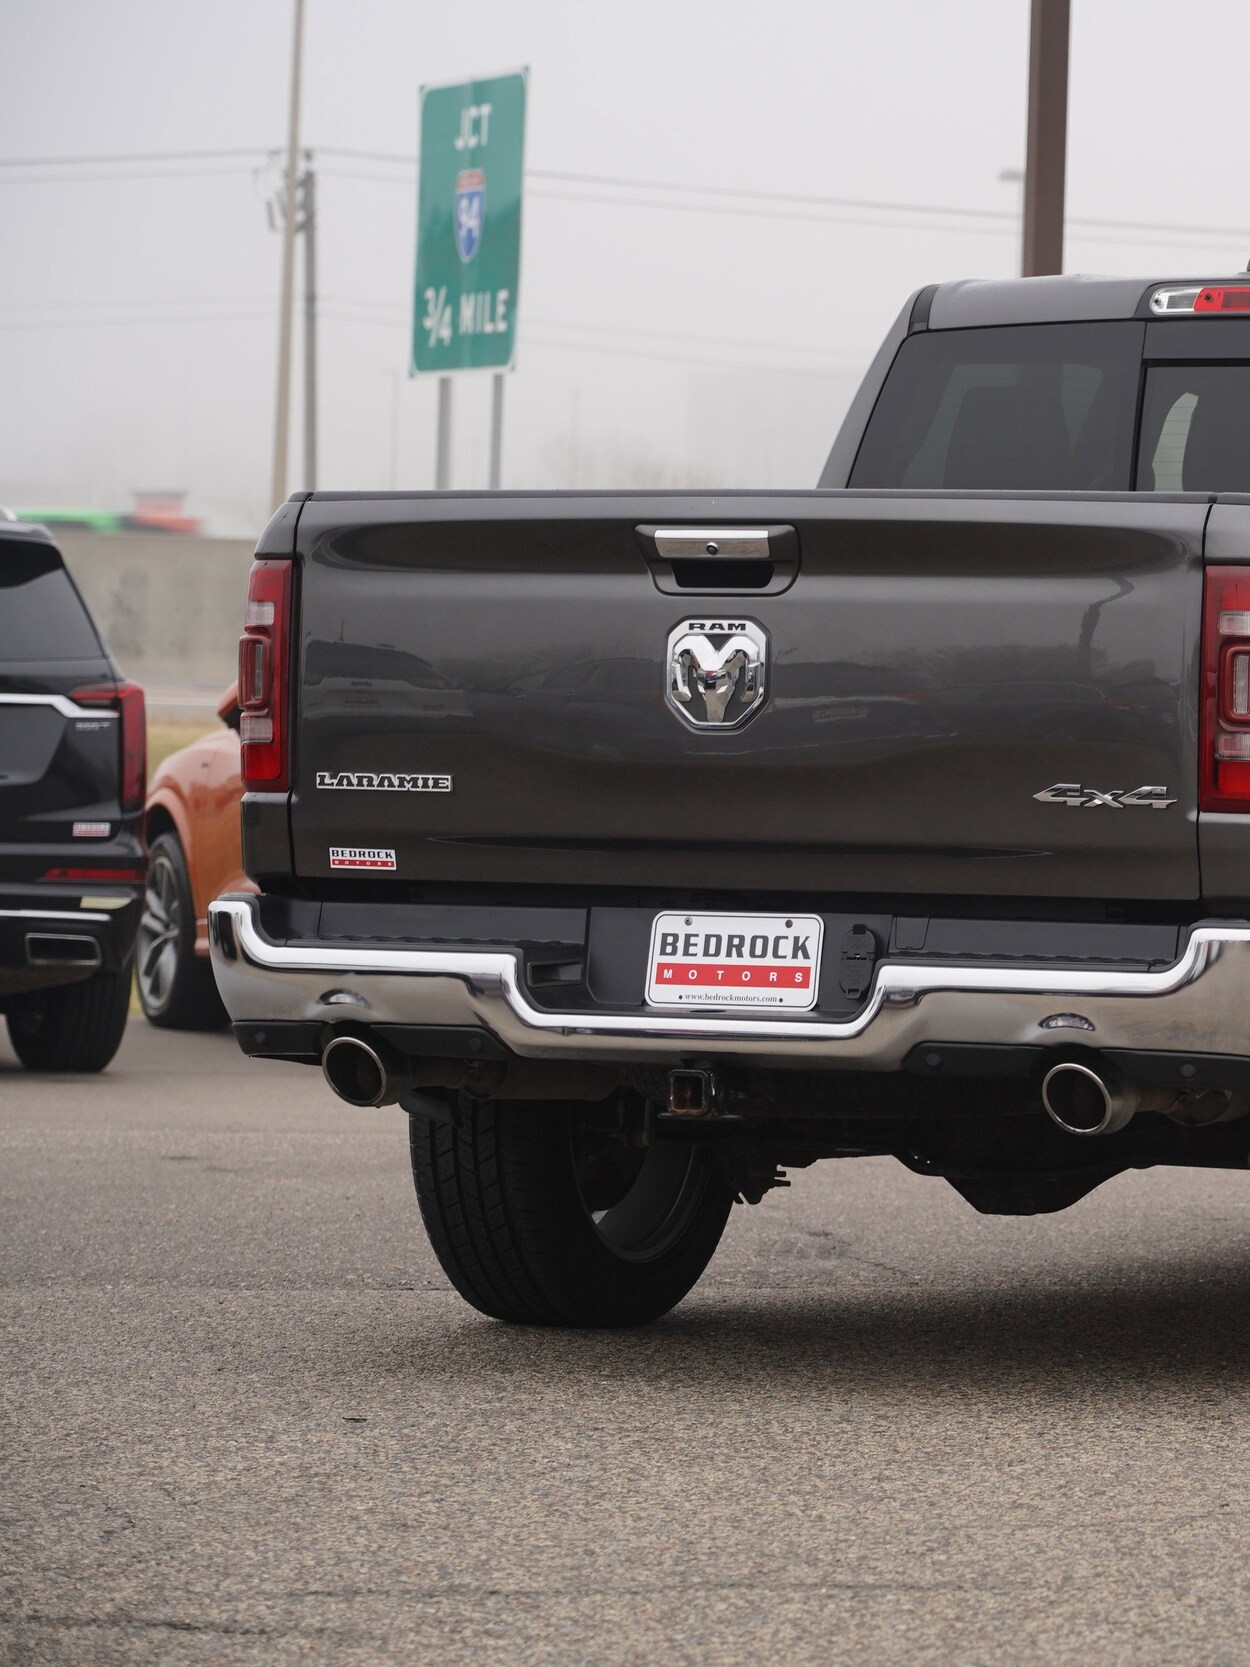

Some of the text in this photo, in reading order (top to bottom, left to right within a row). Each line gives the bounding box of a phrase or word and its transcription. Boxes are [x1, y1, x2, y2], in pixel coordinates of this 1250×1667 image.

[454, 104, 492, 150] JCT
[459, 289, 510, 336] MILE
[688, 622, 747, 631] RAM
[316, 772, 452, 792] LARAMIE
[331, 849, 394, 859] BEDROCK
[659, 932, 811, 960] BEDROCK
[663, 968, 803, 983] MOTORS
[685, 992, 778, 1004] www.bedrockmotors.com
